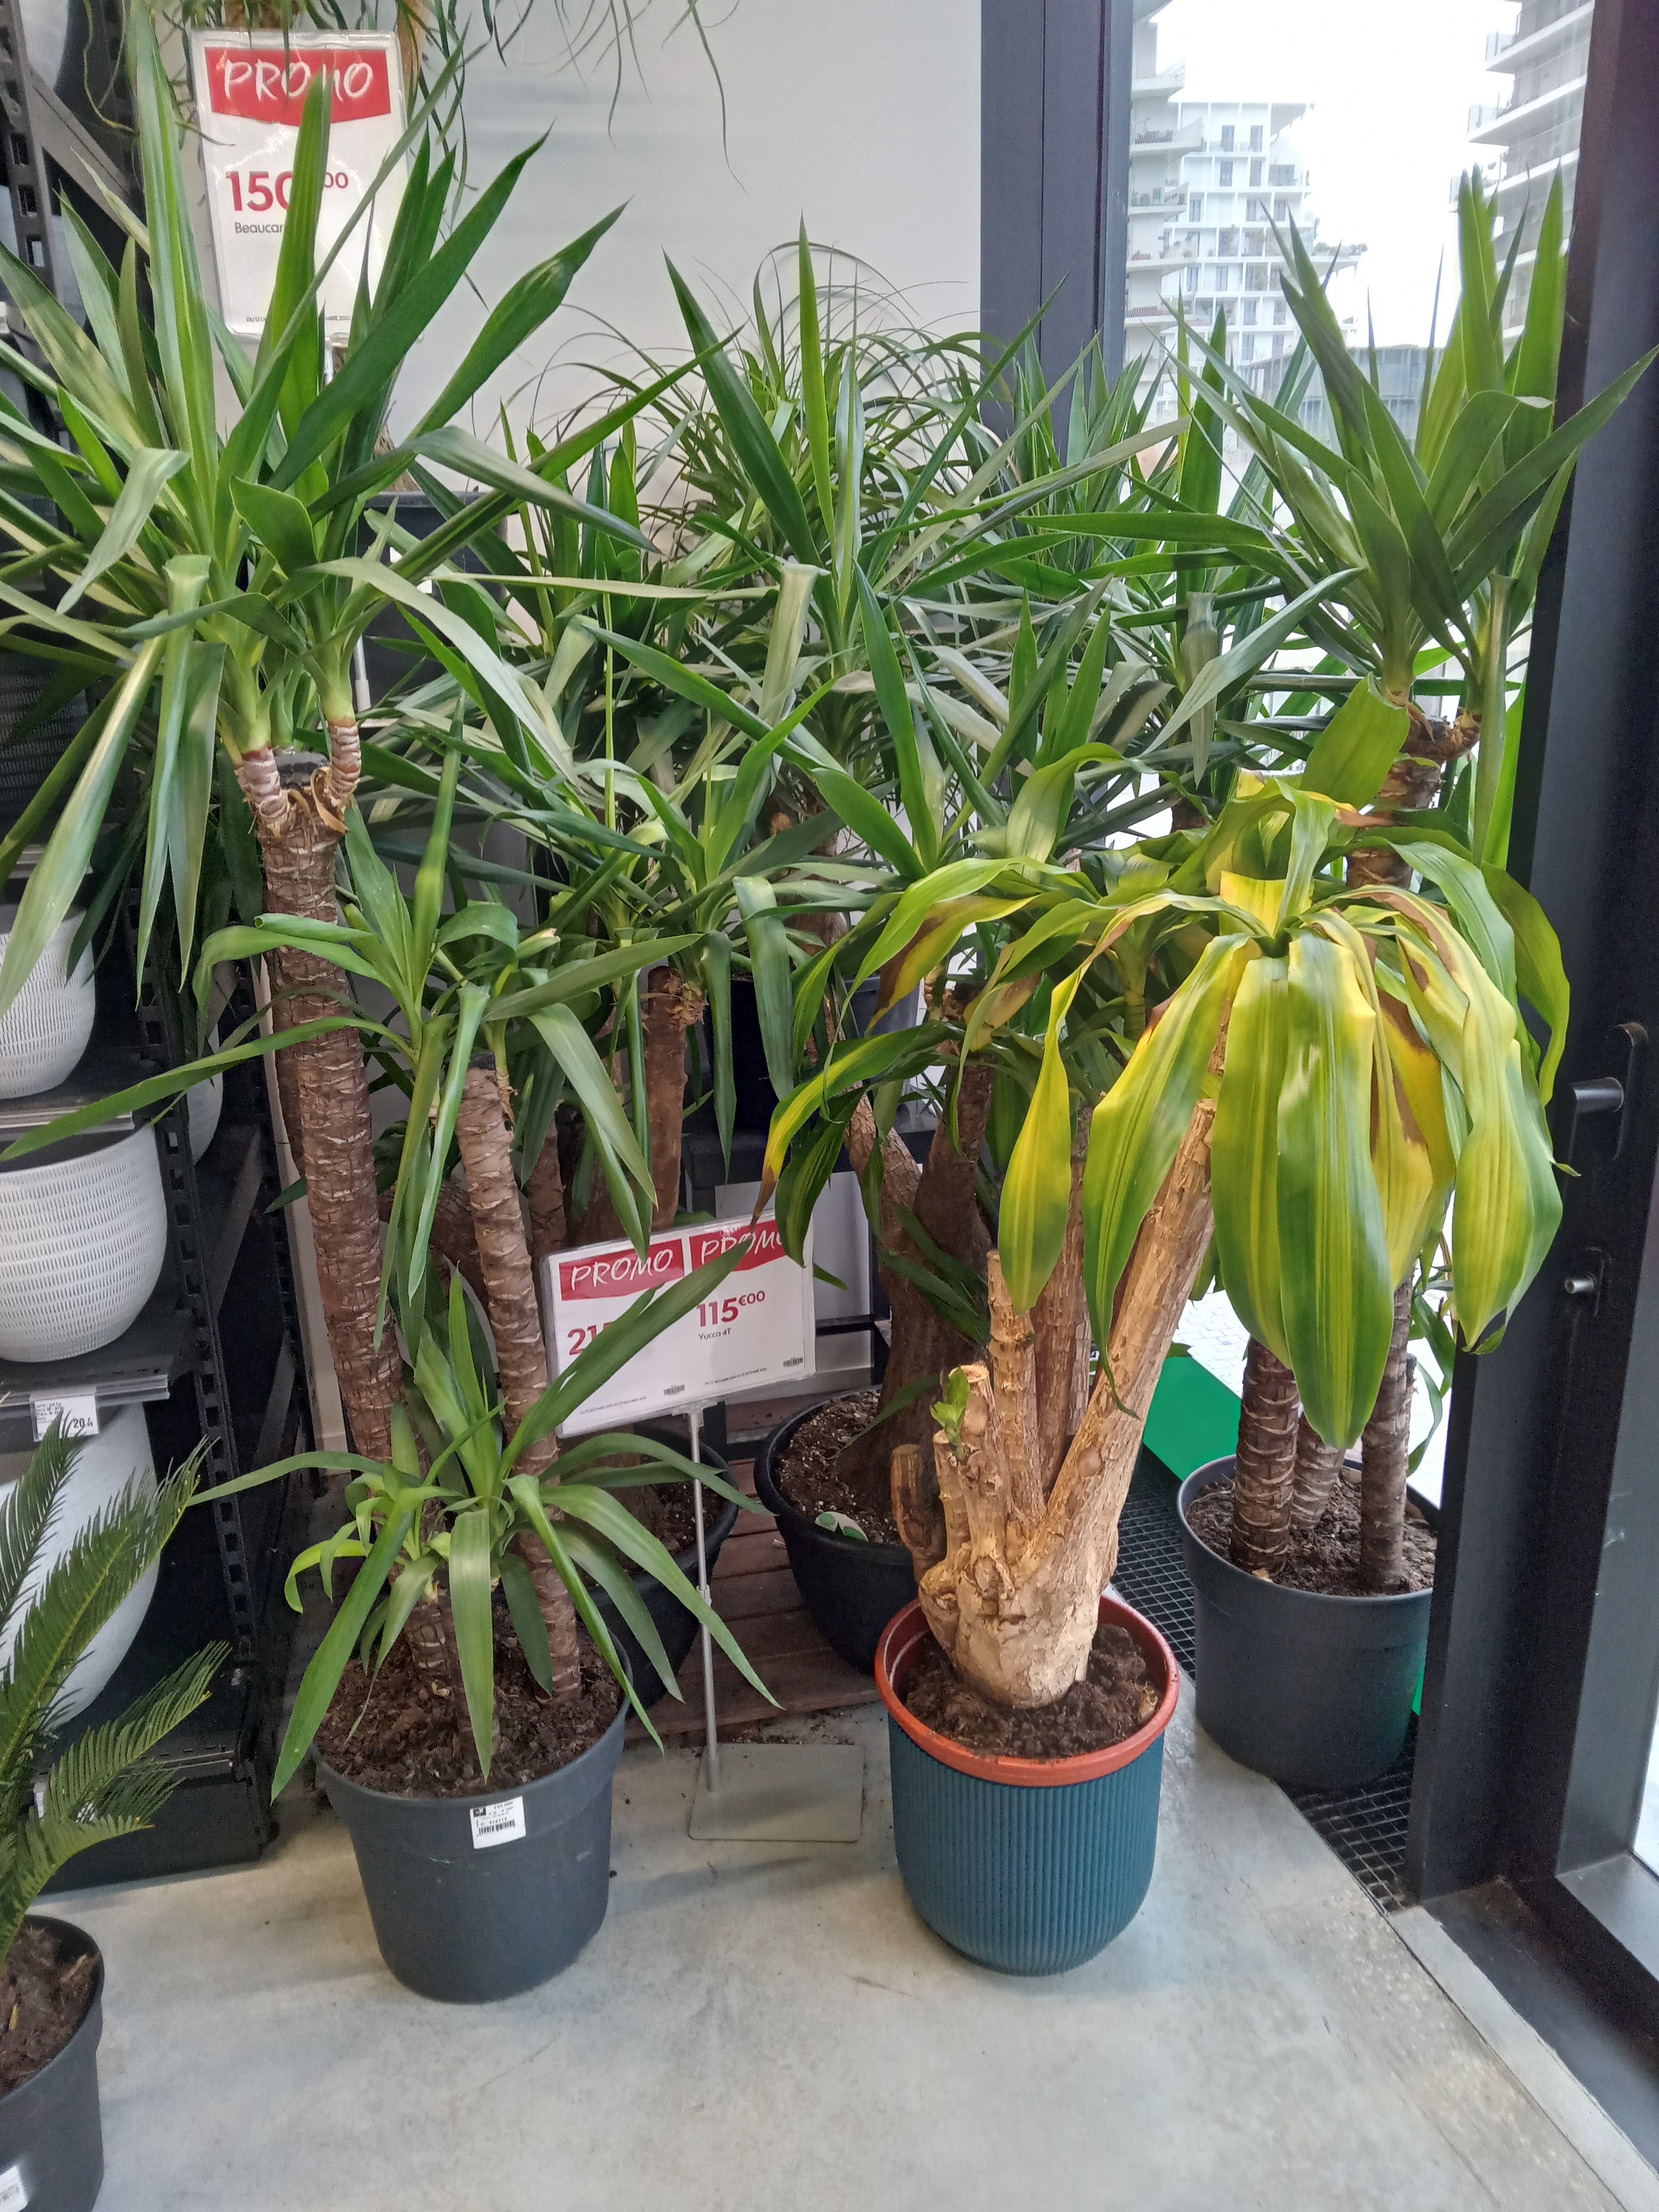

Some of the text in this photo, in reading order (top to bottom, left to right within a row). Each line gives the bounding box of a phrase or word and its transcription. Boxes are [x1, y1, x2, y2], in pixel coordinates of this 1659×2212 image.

[226, 171, 349, 211] 15000
[234, 222, 283, 233] Beaucar
[571, 1249, 673, 1292] PROMO
[697, 1291, 766, 1327] 115€00
[699, 1331, 721, 1340] Yucca
